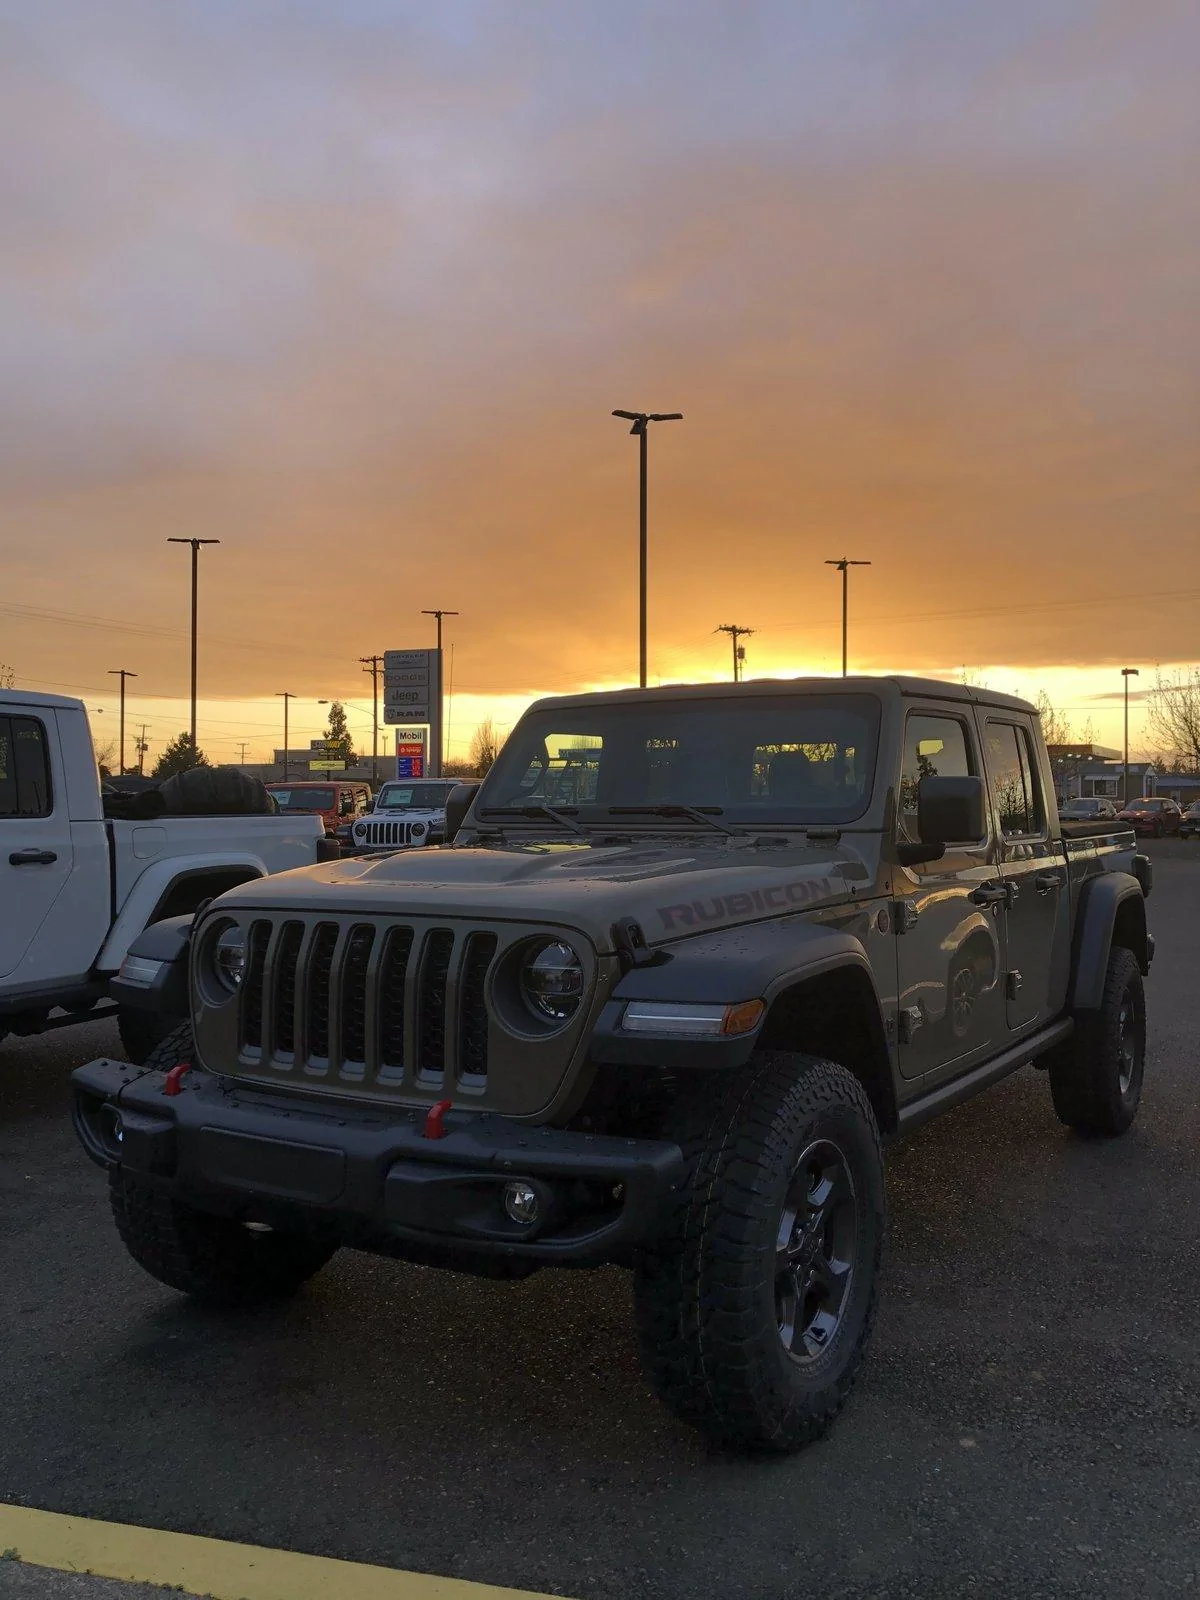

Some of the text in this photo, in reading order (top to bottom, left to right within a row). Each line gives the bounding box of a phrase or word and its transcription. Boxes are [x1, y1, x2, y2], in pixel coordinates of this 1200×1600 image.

[392, 690, 419, 702] Jeep
[399, 732, 422, 740] Mobil
[656, 877, 832, 931] RUBICON
